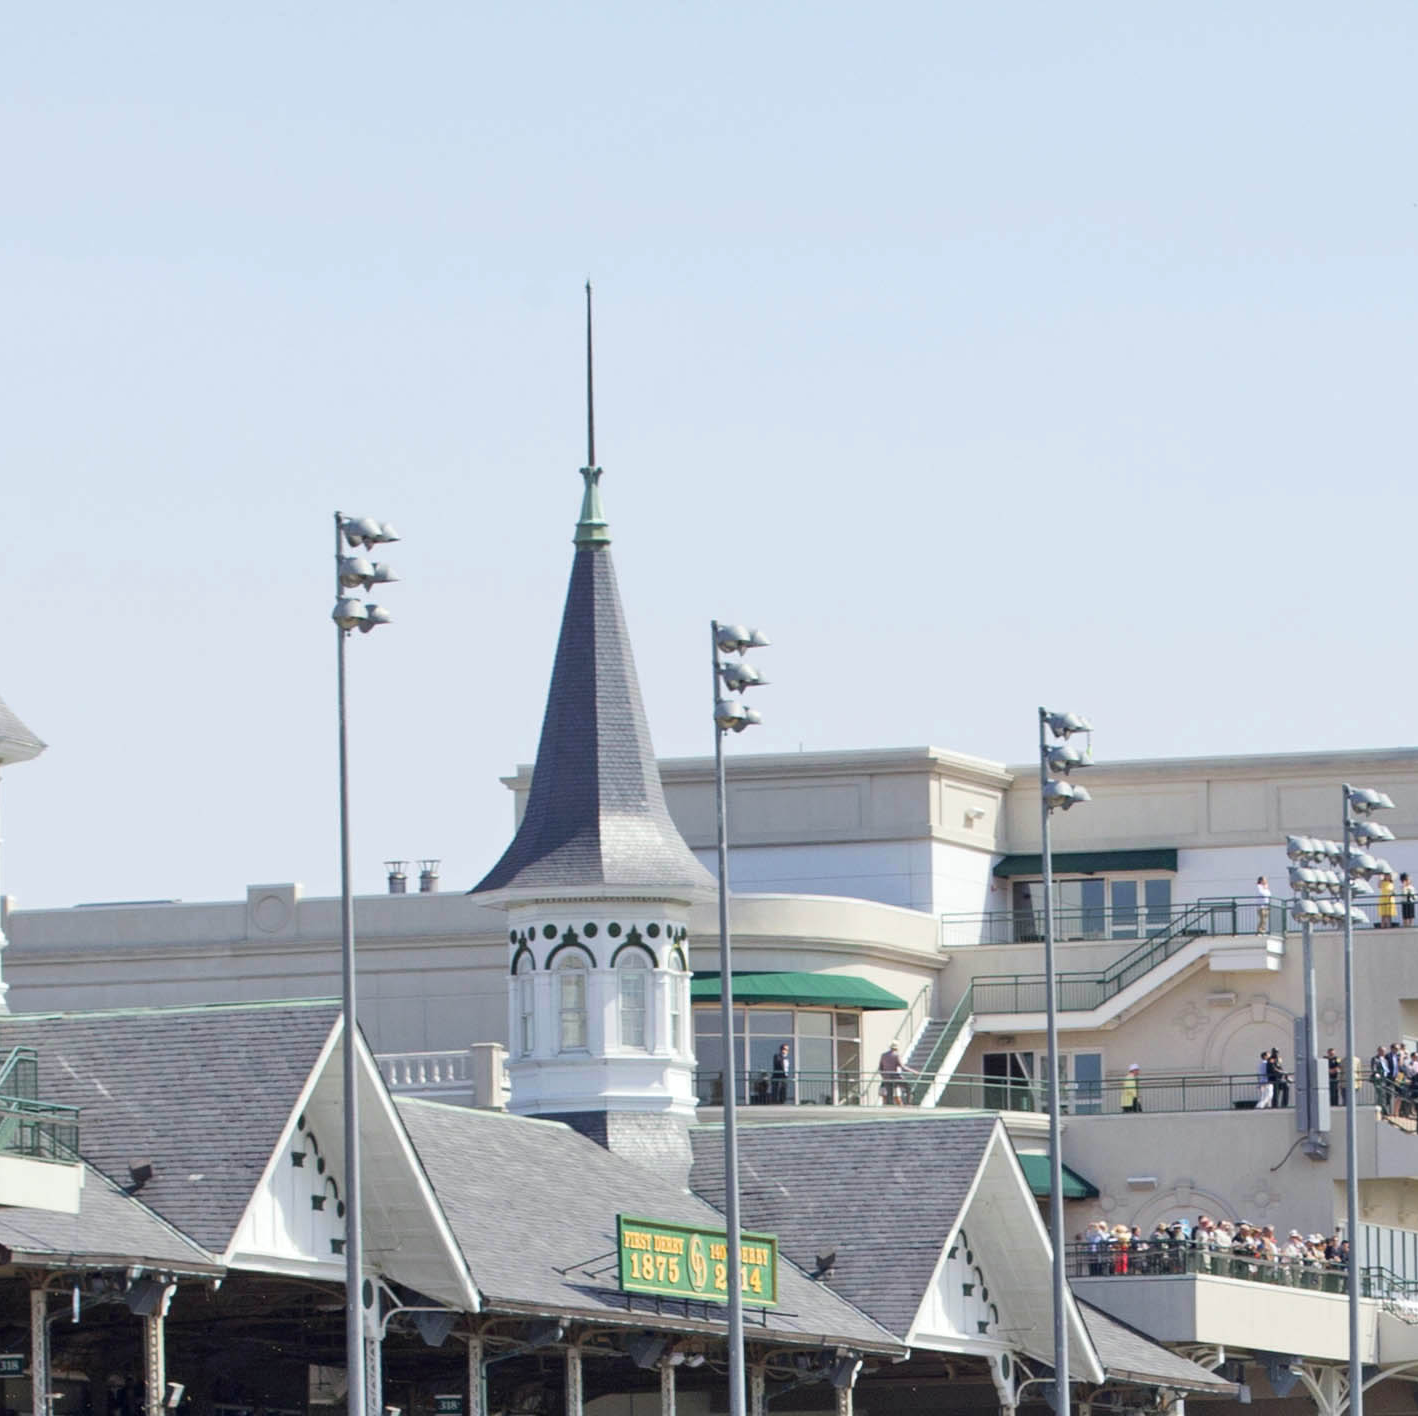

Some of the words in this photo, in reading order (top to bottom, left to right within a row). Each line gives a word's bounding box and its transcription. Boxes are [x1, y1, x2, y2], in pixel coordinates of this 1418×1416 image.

[624, 1231, 652, 1251] FIRST
[653, 1235, 685, 1255] DERBY
[740, 1246, 769, 1266] ERBY
[630, 1253, 680, 1283] 1875
[714, 1264, 763, 1294] 214
